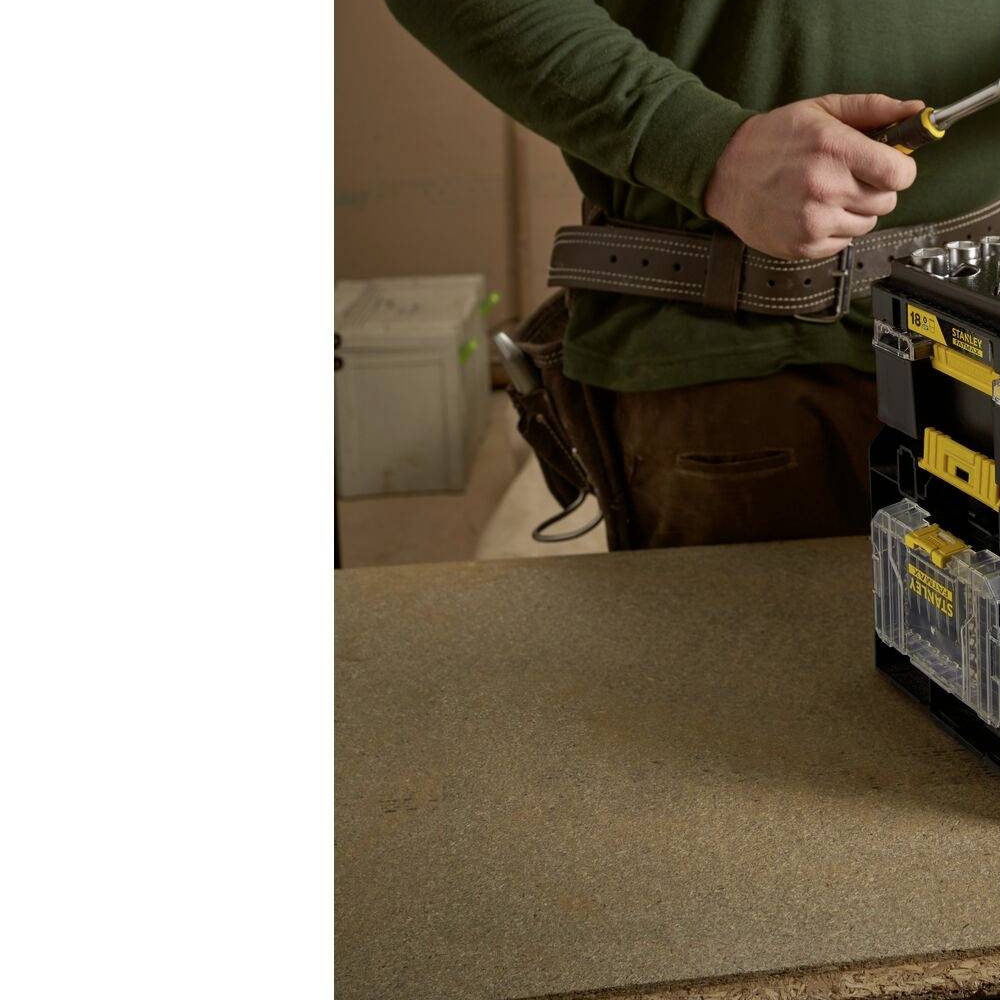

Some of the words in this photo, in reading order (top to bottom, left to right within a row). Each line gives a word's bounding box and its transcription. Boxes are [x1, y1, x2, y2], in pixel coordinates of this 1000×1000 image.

[910, 311, 921, 328] 18
[951, 327, 983, 349] STANLEY
[909, 577, 954, 618] STANLEY
